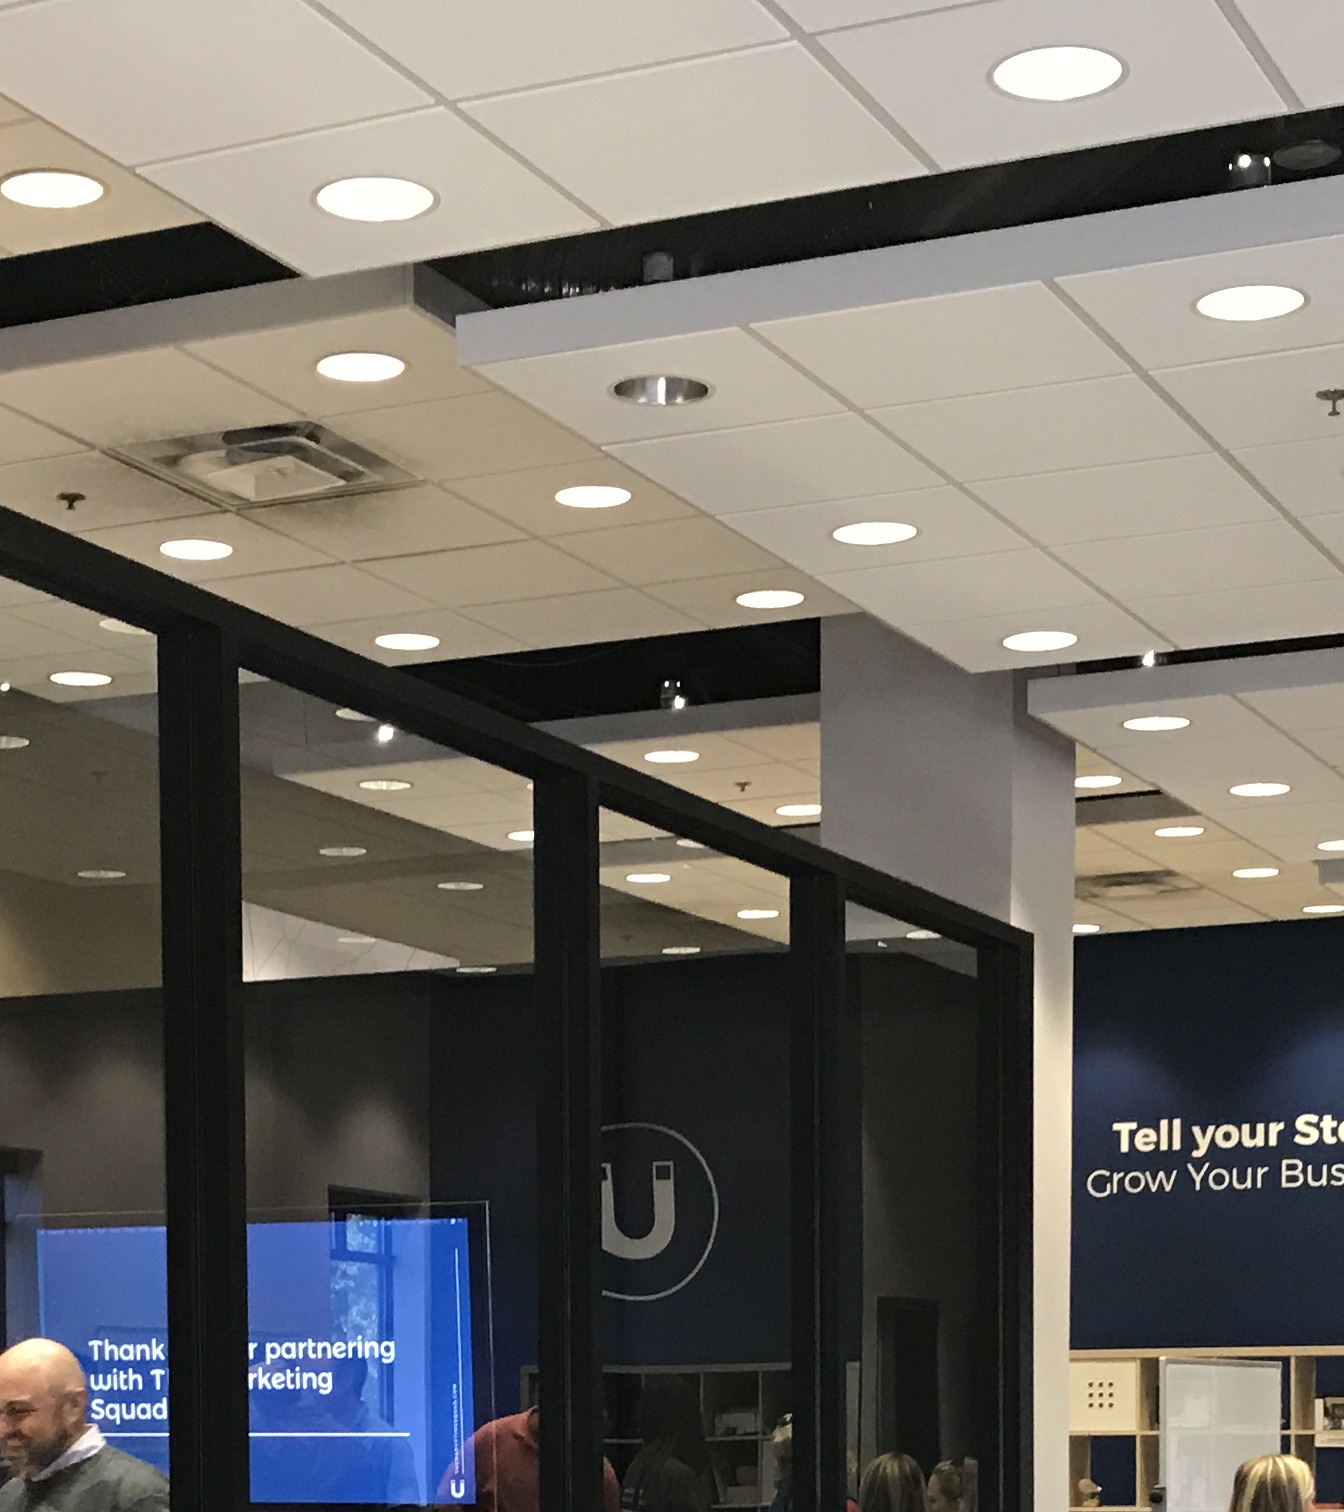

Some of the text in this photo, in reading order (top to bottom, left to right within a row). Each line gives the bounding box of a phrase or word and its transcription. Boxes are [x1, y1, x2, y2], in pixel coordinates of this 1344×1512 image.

[1112, 1118, 1182, 1154] Tell
[1191, 1119, 1285, 1158] your
[1086, 1168, 1178, 1199] Grow
[1187, 1161, 1270, 1192] Your
[88, 1338, 166, 1361] Thank
[265, 1336, 396, 1364] partnering
[90, 1368, 143, 1391] with
[248, 1367, 333, 1395] rketing
[91, 1397, 168, 1425] Squad
